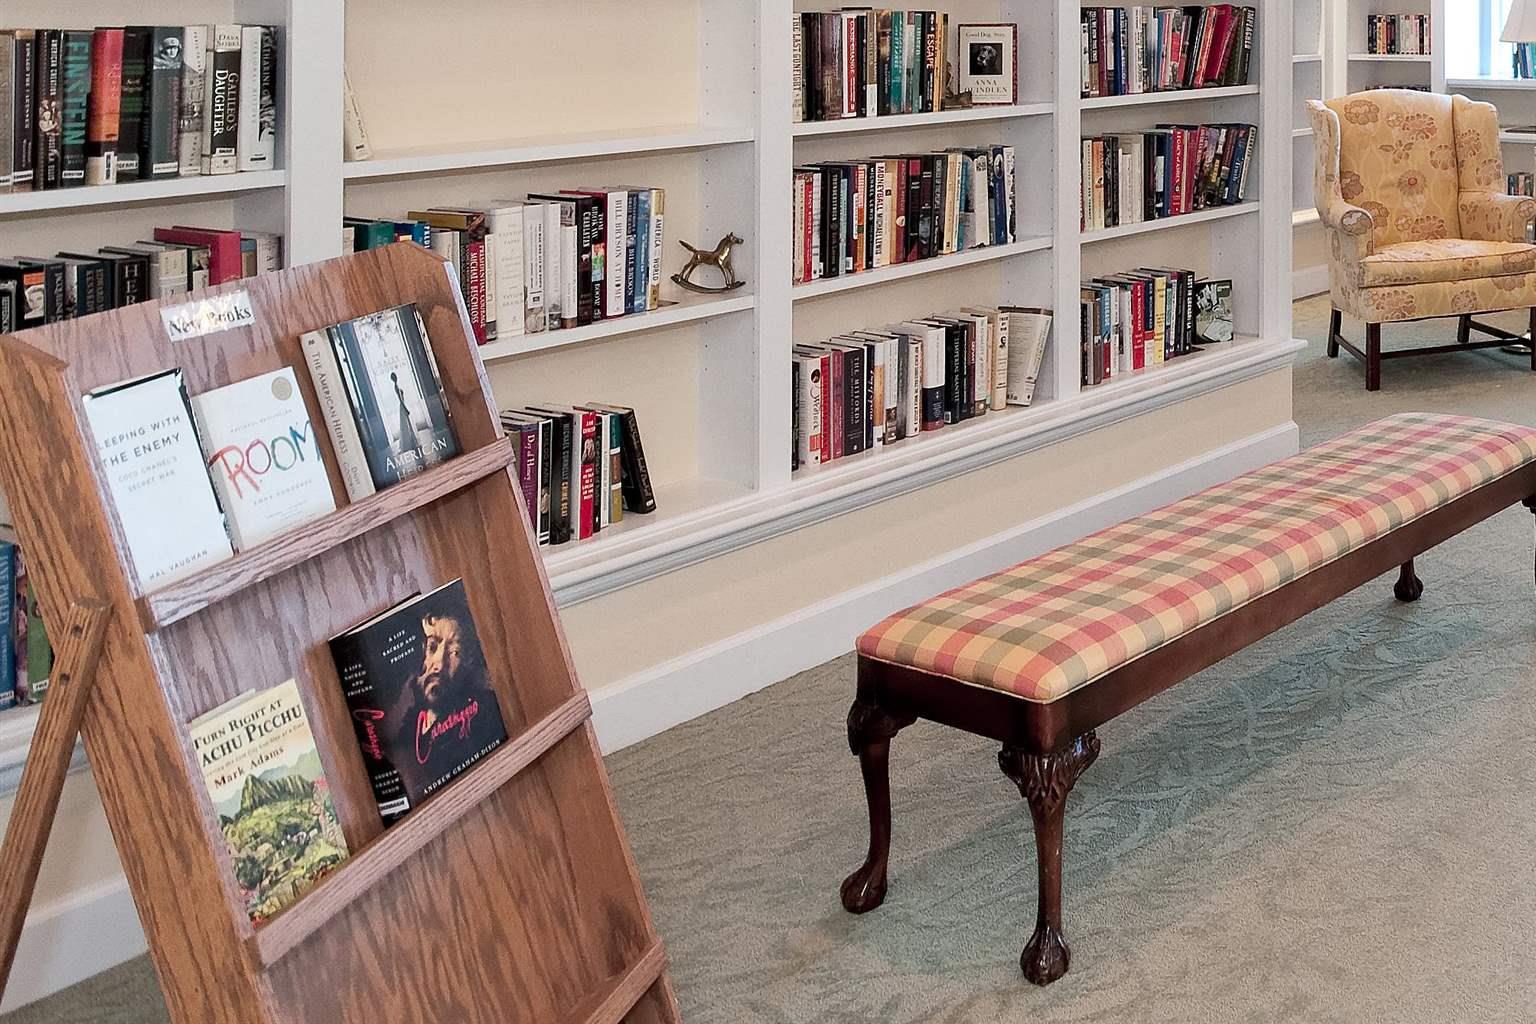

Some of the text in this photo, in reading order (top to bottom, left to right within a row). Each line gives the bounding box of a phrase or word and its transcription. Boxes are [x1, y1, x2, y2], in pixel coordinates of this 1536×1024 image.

[793, 33, 801, 53] LAST
[926, 34, 935, 69] ESCAPE
[793, 54, 801, 91] GUNFIGHT
[63, 41, 89, 145] EINSTEIN
[213, 69, 229, 136] DAUGHTER
[226, 72, 240, 132] GALILEO'S
[615, 199, 623, 220] BILL
[874, 166, 885, 255] MONEYBALL MICHAEL LEWIS
[615, 223, 623, 258] BRYSON
[652, 218, 662, 281] AMERICA WORLD
[470, 252, 479, 324] MICHAEL BESCHLOSS
[311, 352, 348, 455] THE AMERICAN HEIRESS
[95, 414, 181, 451] LEEPING WITH
[102, 432, 182, 468] THE ENEMY
[524, 434, 536, 449] Day
[562, 423, 570, 450] MICHAEL
[208, 419, 321, 500] ROOM
[385, 437, 448, 472] AMERICAN
[523, 457, 535, 481] Honey
[561, 451, 570, 480] CONNELLY
[561, 481, 570, 501] CRIME
[149, 549, 209, 581] HAL VAUGHAN
[193, 699, 283, 750] TURN RIGHT AT
[201, 704, 303, 768] ACHU PICCHU
[214, 766, 244, 789] Mark
[249, 746, 284, 769] Adams
[422, 738, 501, 796] ANDREW GRAHAM-DIXON
